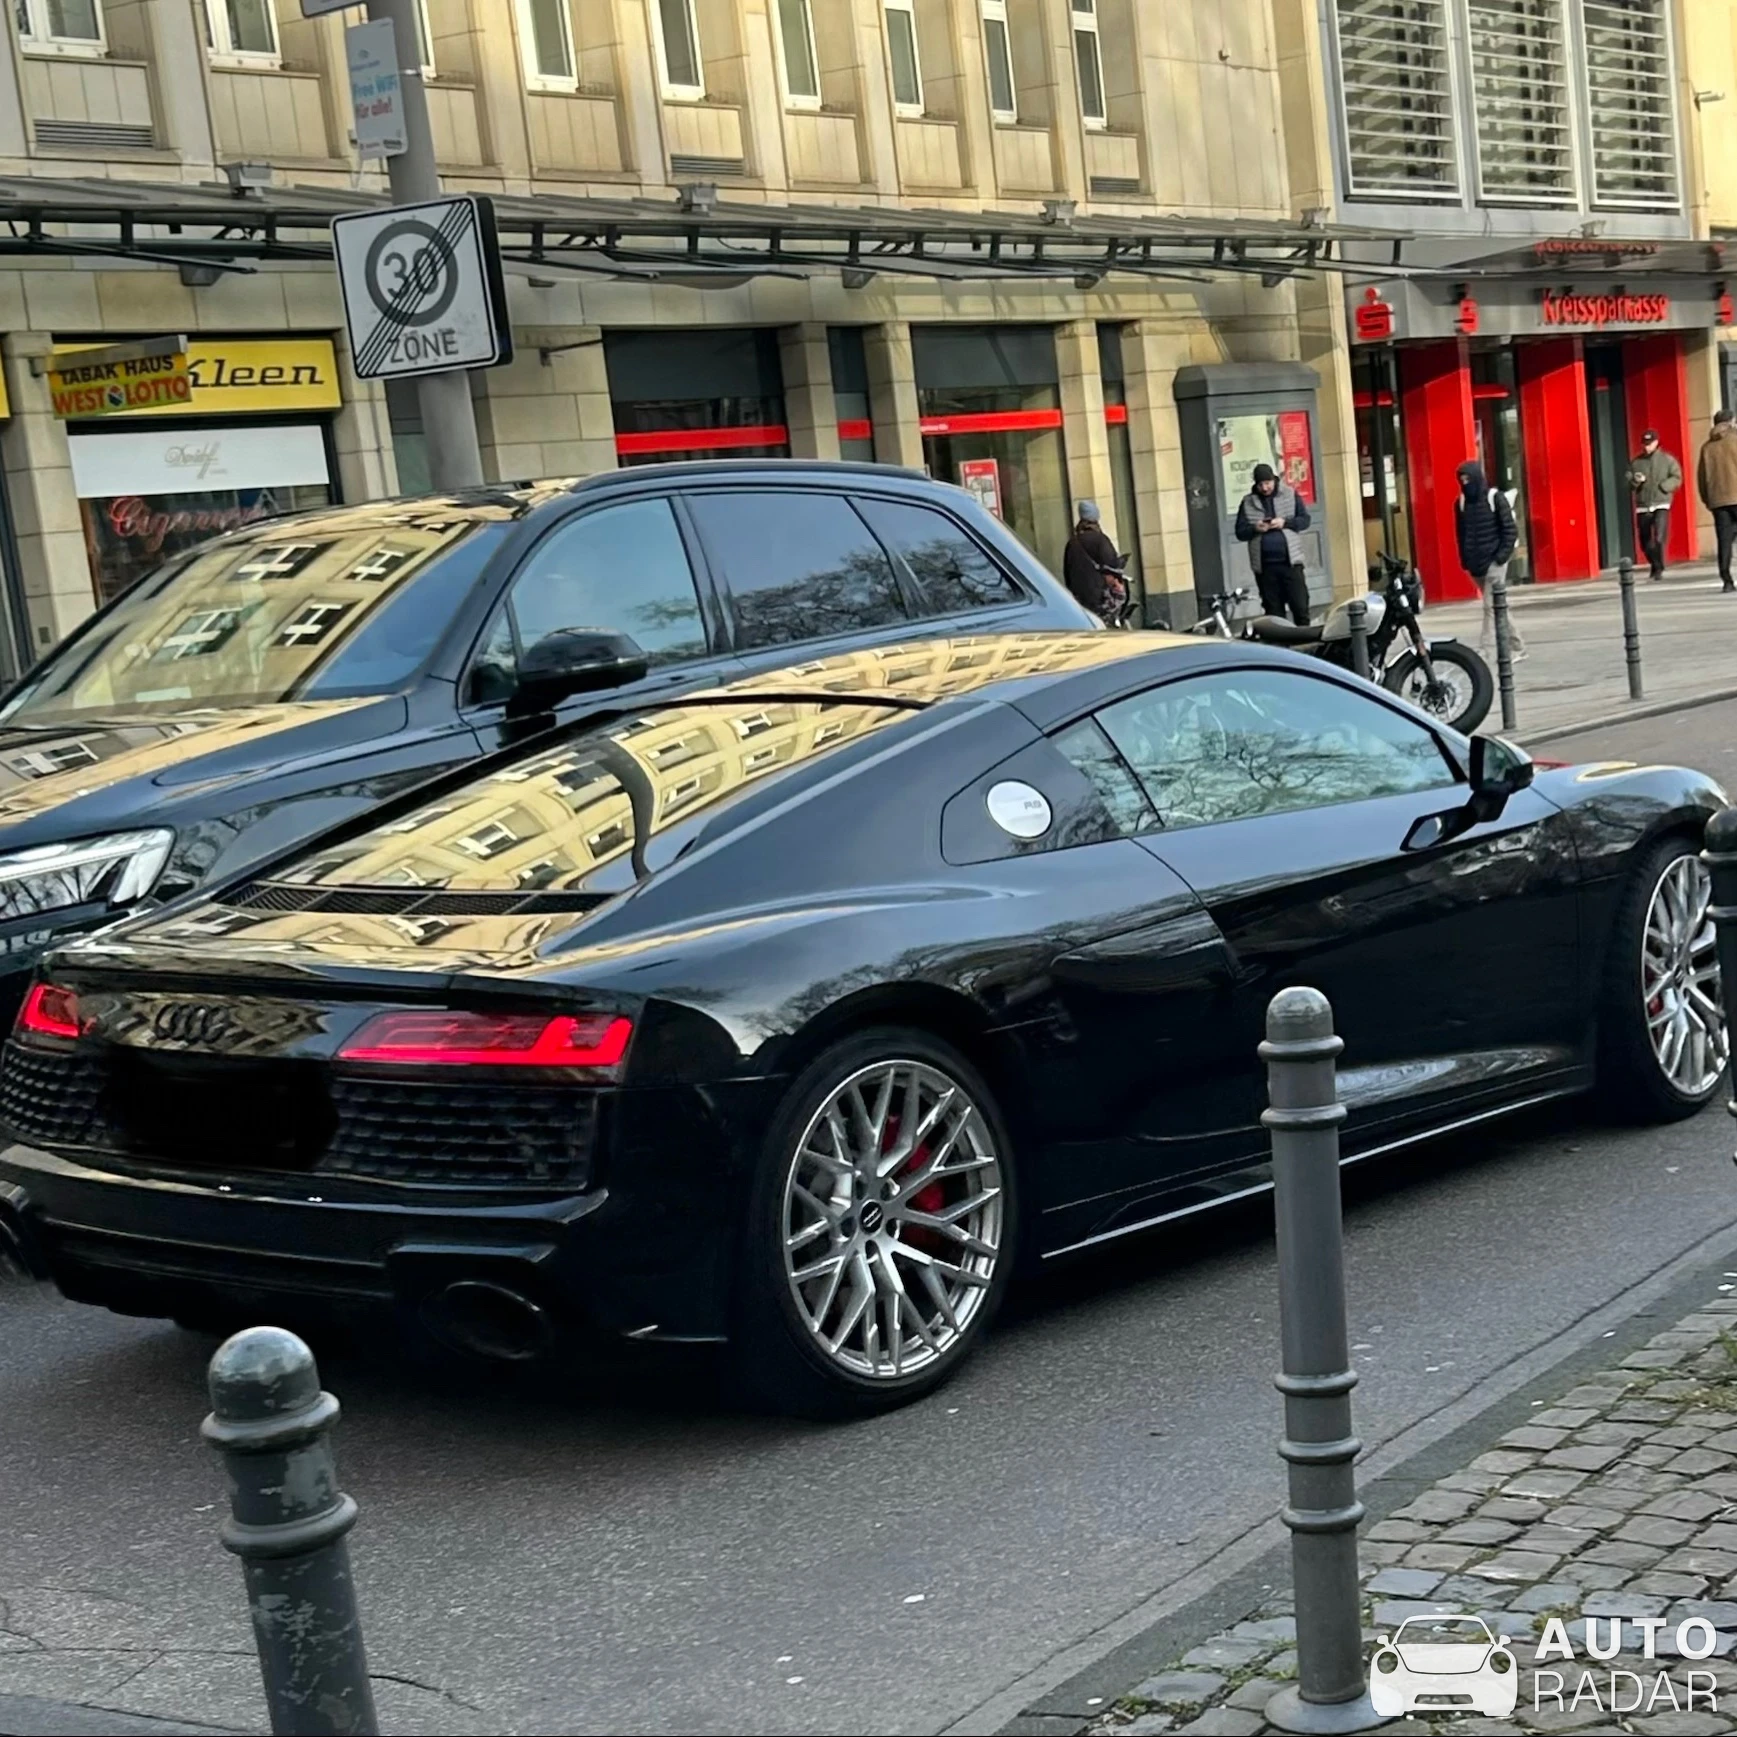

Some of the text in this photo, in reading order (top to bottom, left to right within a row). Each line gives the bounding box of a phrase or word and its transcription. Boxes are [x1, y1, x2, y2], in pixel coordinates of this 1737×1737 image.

[384, 247, 439, 301] 30
[1541, 287, 1669, 331] Kreissparkasse
[390, 329, 460, 364] ZONE
[62, 355, 174, 385] TABAK HAUS
[53, 377, 189, 415] WEST LOTTO
